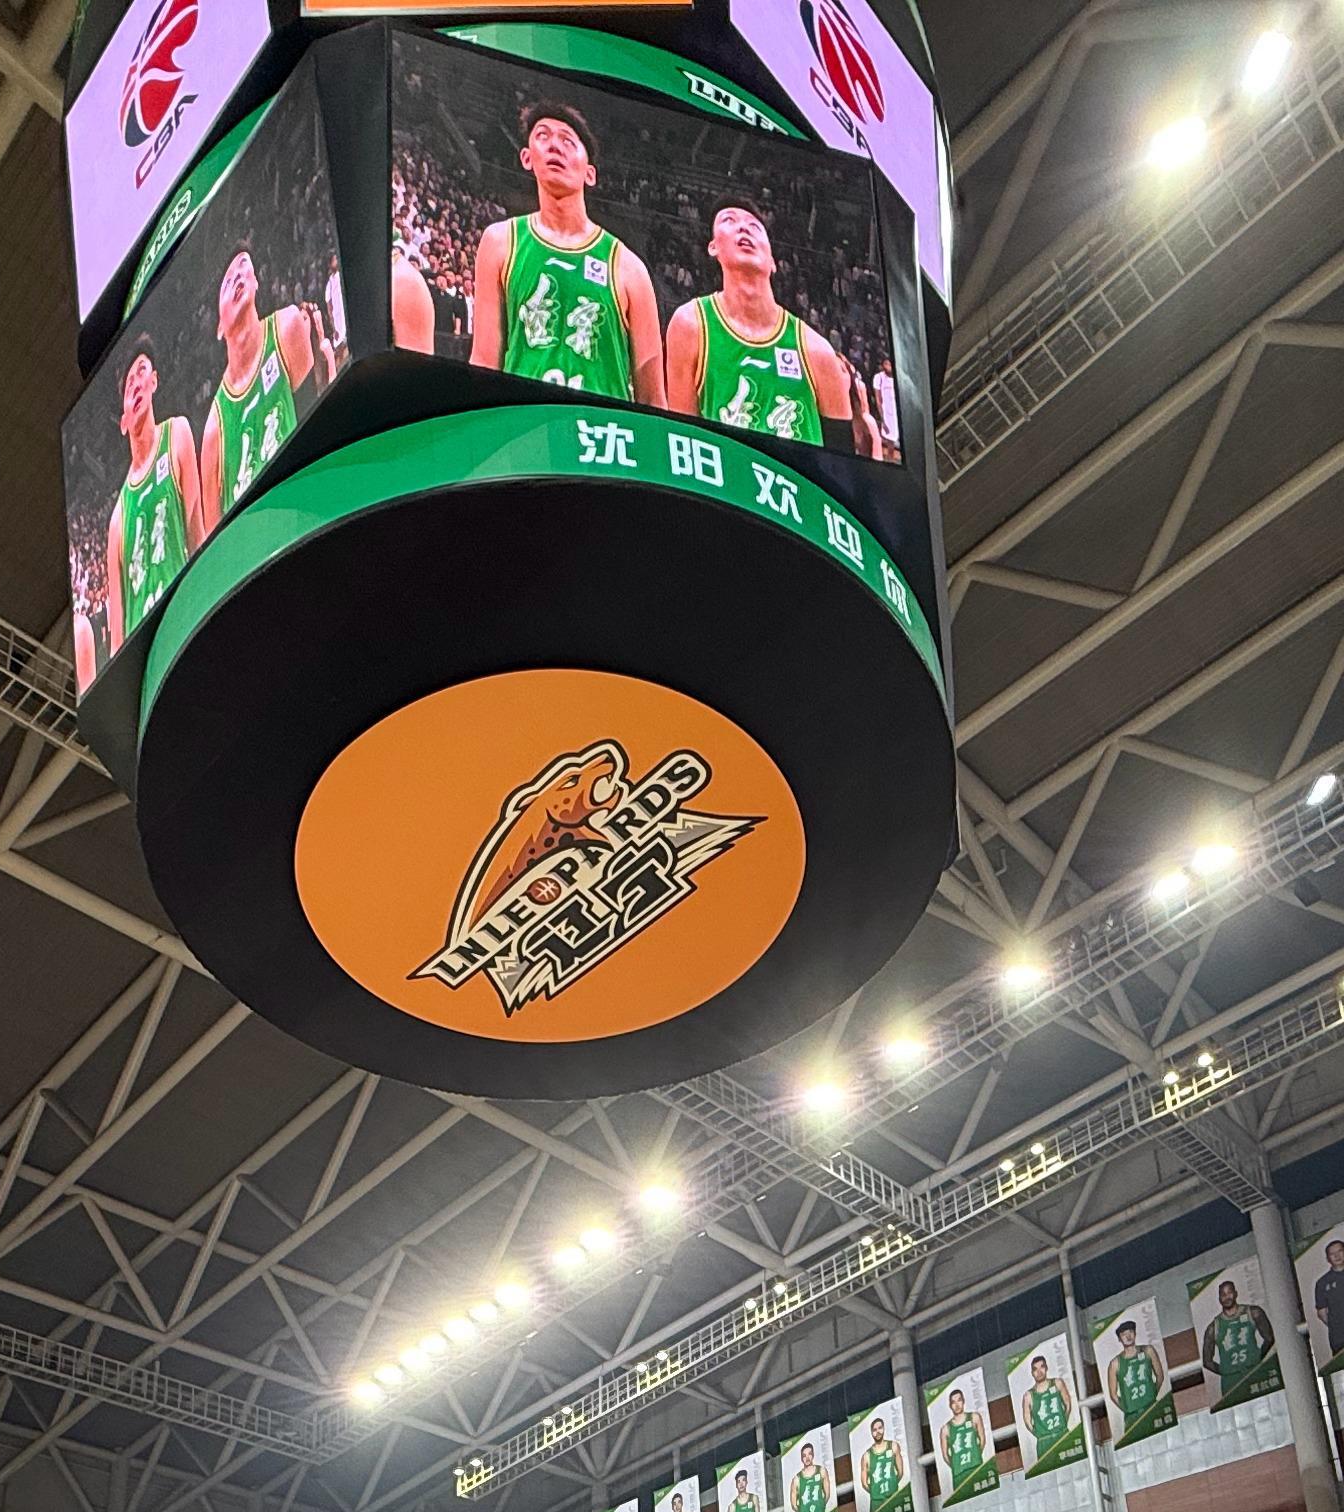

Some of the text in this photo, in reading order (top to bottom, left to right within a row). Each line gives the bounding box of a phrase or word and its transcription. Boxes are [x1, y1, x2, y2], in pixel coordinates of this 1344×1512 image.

[809, 66, 873, 160] CBA
[135, 94, 199, 190] CBA
[576, 419, 912, 625] 沈阳欢迎你
[1231, 1351, 1247, 1366] 25
[1131, 1385, 1146, 1400] 23
[1047, 1416, 1060, 1431] 22
[960, 1452, 972, 1466] 21
